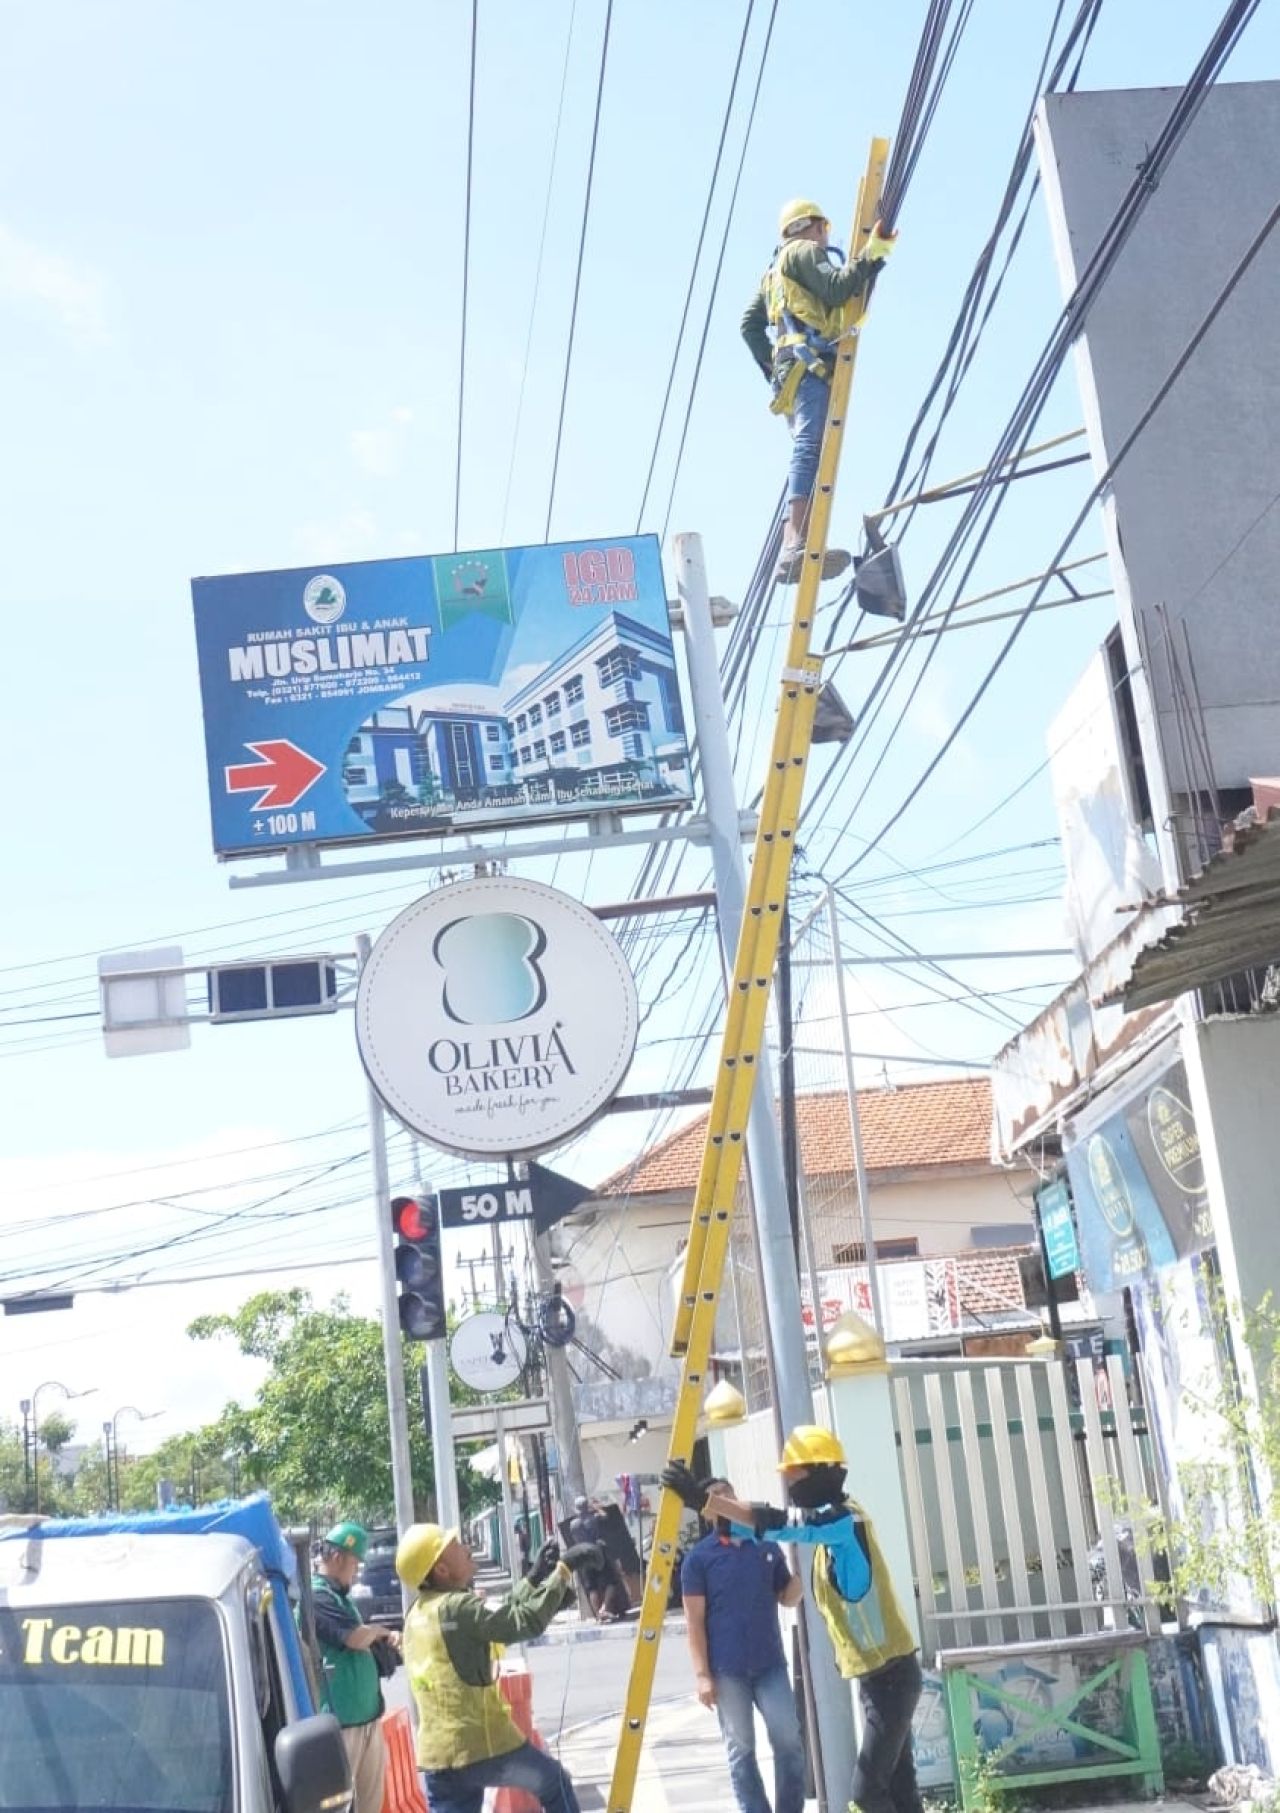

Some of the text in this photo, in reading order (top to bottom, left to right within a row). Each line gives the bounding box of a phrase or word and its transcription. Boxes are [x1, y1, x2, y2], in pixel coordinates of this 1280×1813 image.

[562, 547, 635, 587] IGD
[568, 580, 639, 607] 24 JAM
[247, 617, 409, 643] RUMAH SAKIT IBU & ANAK
[228, 626, 432, 682] MUSLIMAT
[267, 813, 298, 836] 100
[301, 810, 316, 832] M
[445, 1063, 558, 1096] BAKERY
[517, 1095, 535, 1116] for
[461, 1188, 534, 1220] 50 M
[21, 1618, 165, 1667] Team
